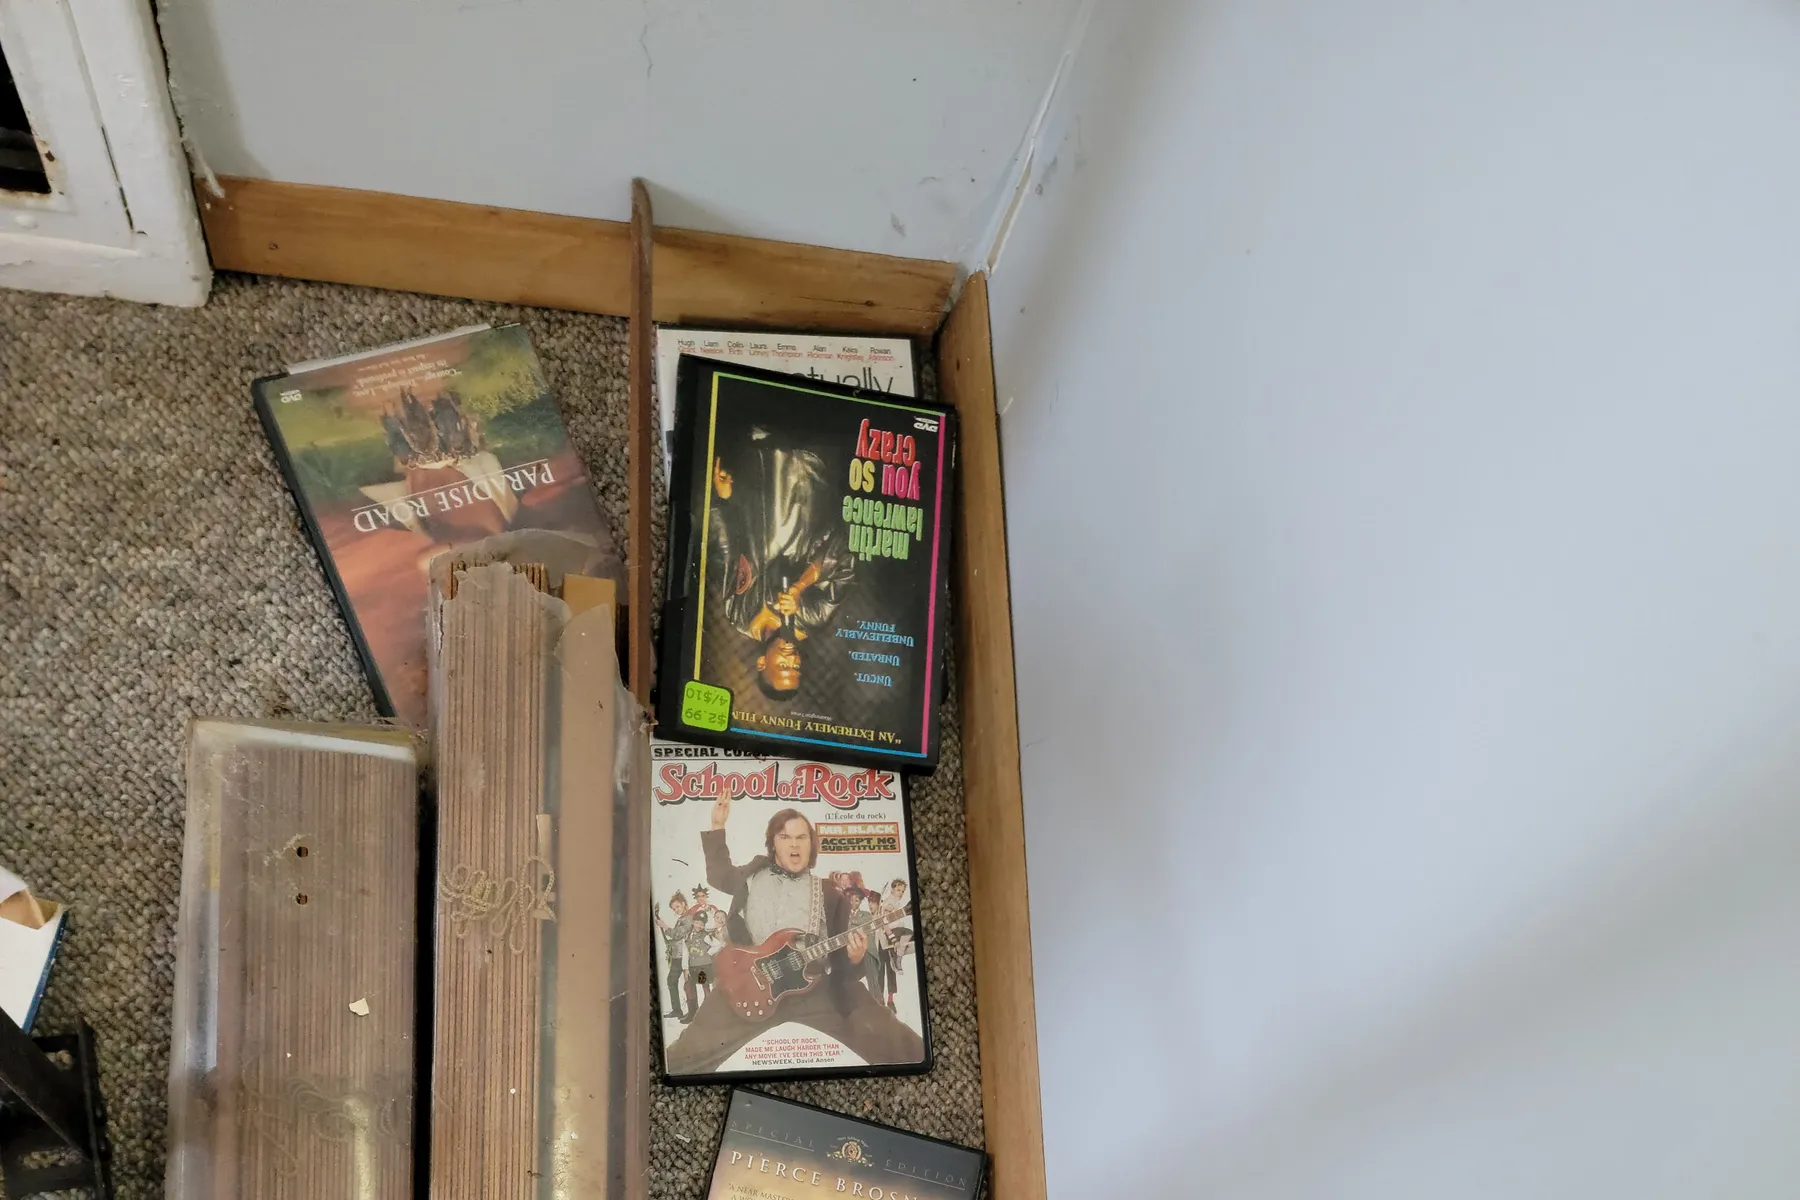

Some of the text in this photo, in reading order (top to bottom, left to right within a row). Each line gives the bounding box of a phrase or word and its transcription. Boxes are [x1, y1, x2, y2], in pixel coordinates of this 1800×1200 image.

[913, 422, 938, 433] DVD
[855, 418, 916, 467] crazy
[849, 458, 921, 500] you so
[353, 463, 556, 533] PARADISE ROAD
[842, 495, 923, 541] lawrence
[849, 524, 909, 562] martin
[835, 627, 914, 647] UNBELIEVABLY
[848, 650, 900, 667] UNRATED.
[854, 672, 892, 687] UNCUT.
[685, 687, 728, 706] 4/$10
[685, 708, 727, 726] $2.99
[760, 715, 801, 731] FUNNY
[803, 723, 875, 743] EXTREMELY
[654, 747, 719, 758] SPECIAL
[653, 762, 896, 810] School of Rock
[855, 812, 865, 820] du
[821, 836, 896, 846] ACCEPT NO
[731, 1120, 815, 1148] SPECIAL
[731, 1150, 821, 1186] PIERCE
[885, 1159, 966, 1186] EDITION
[737, 1185, 758, 1198] NEAR
